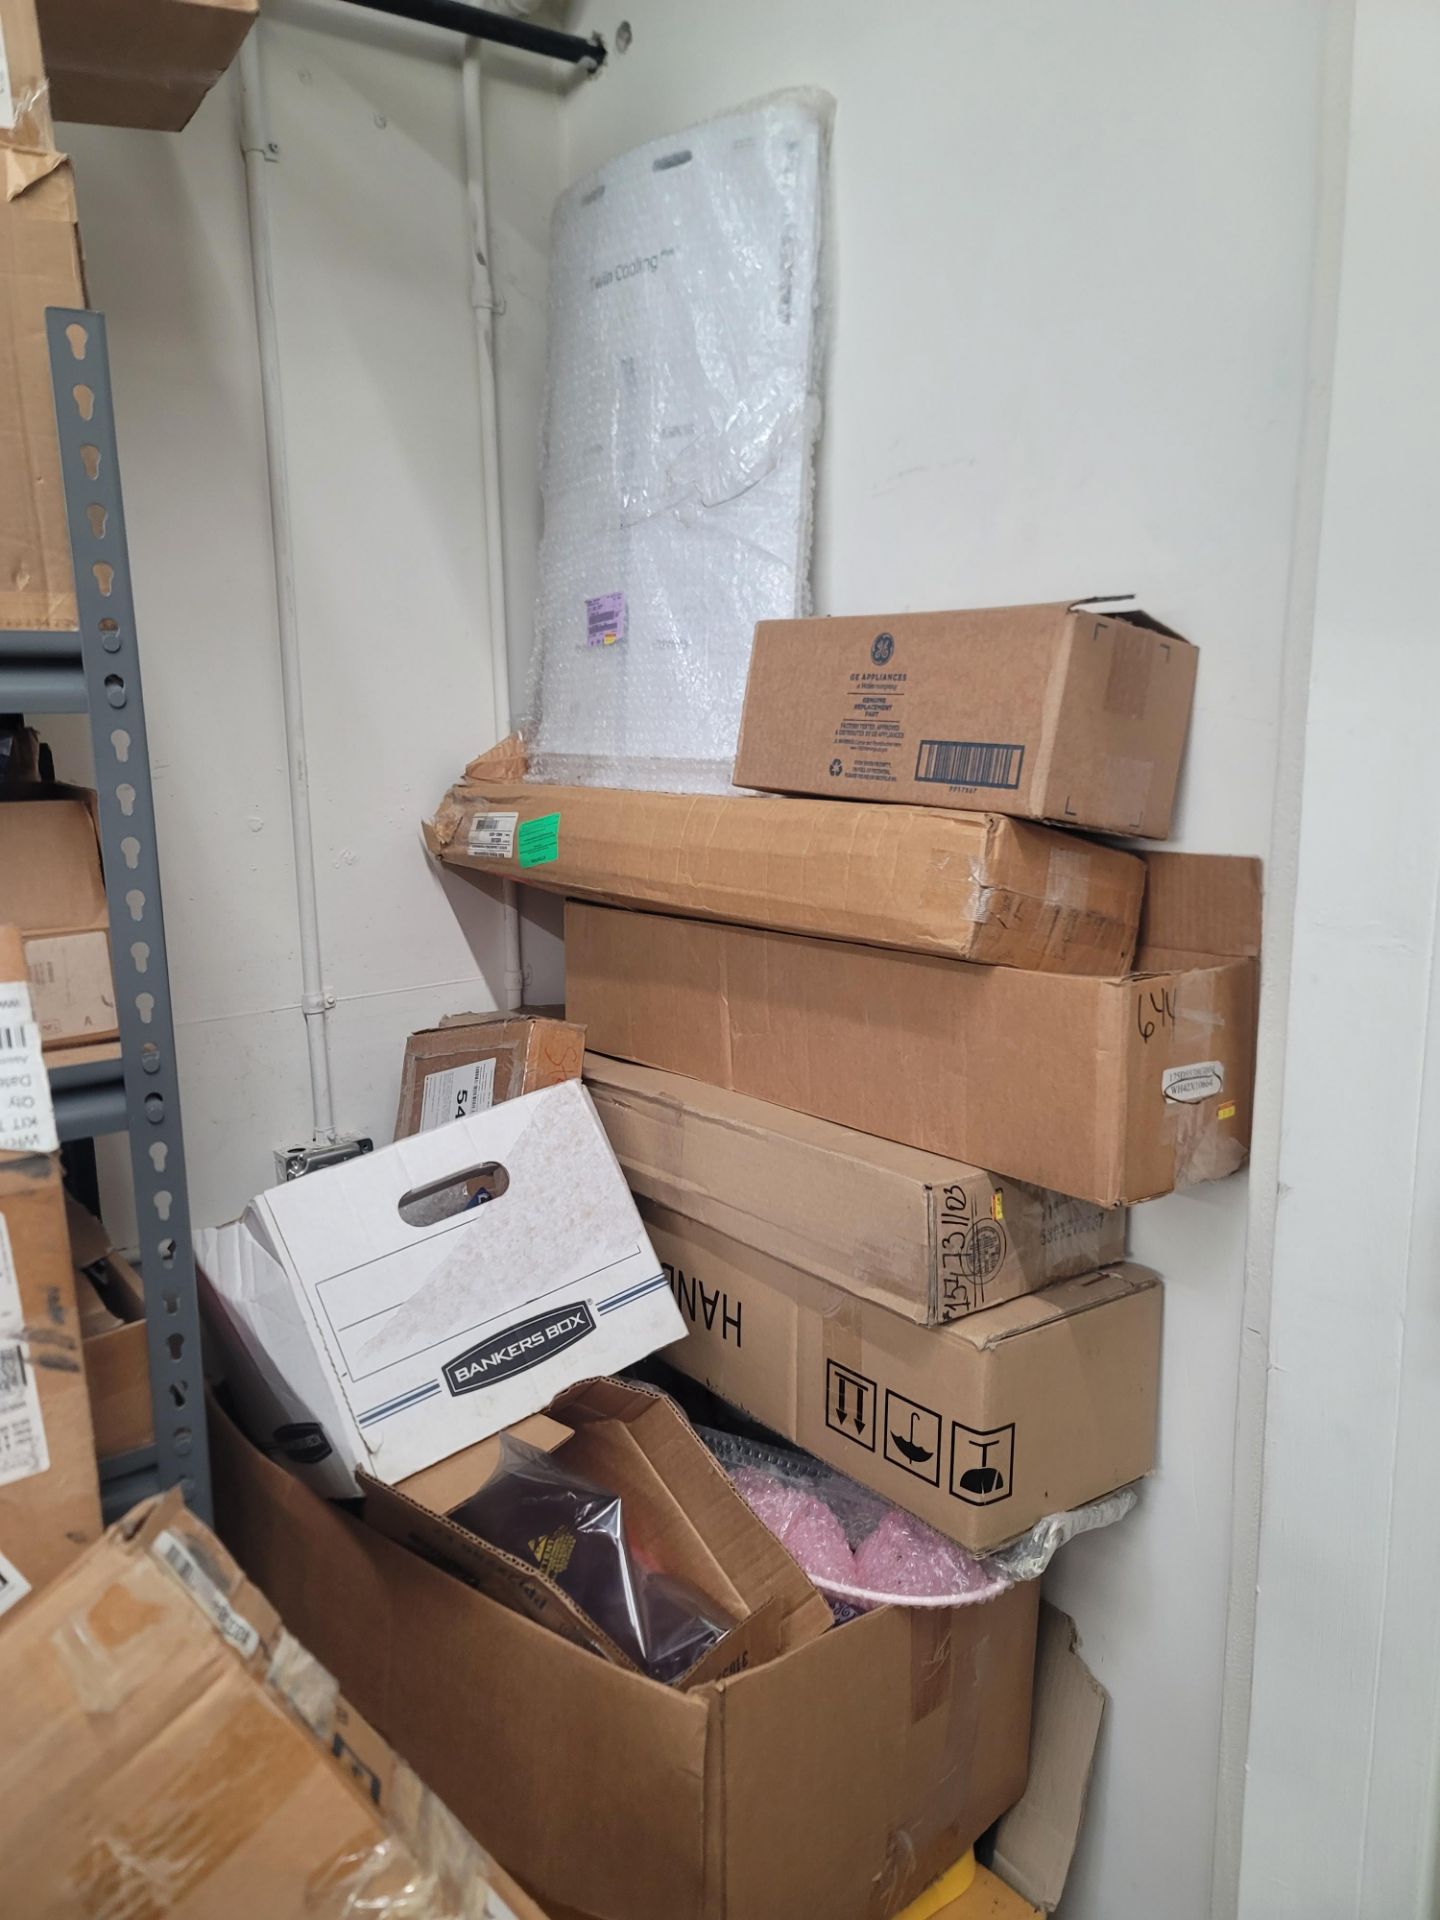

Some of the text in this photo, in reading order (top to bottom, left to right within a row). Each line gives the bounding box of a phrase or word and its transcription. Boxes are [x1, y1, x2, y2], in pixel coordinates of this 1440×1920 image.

[849, 673, 907, 681] GE APPLIANCES
[854, 703, 893, 711] REPLACEMENT
[9, 1095, 36, 1109] Qty
[454, 1312, 586, 1383] BANKERS BOX
